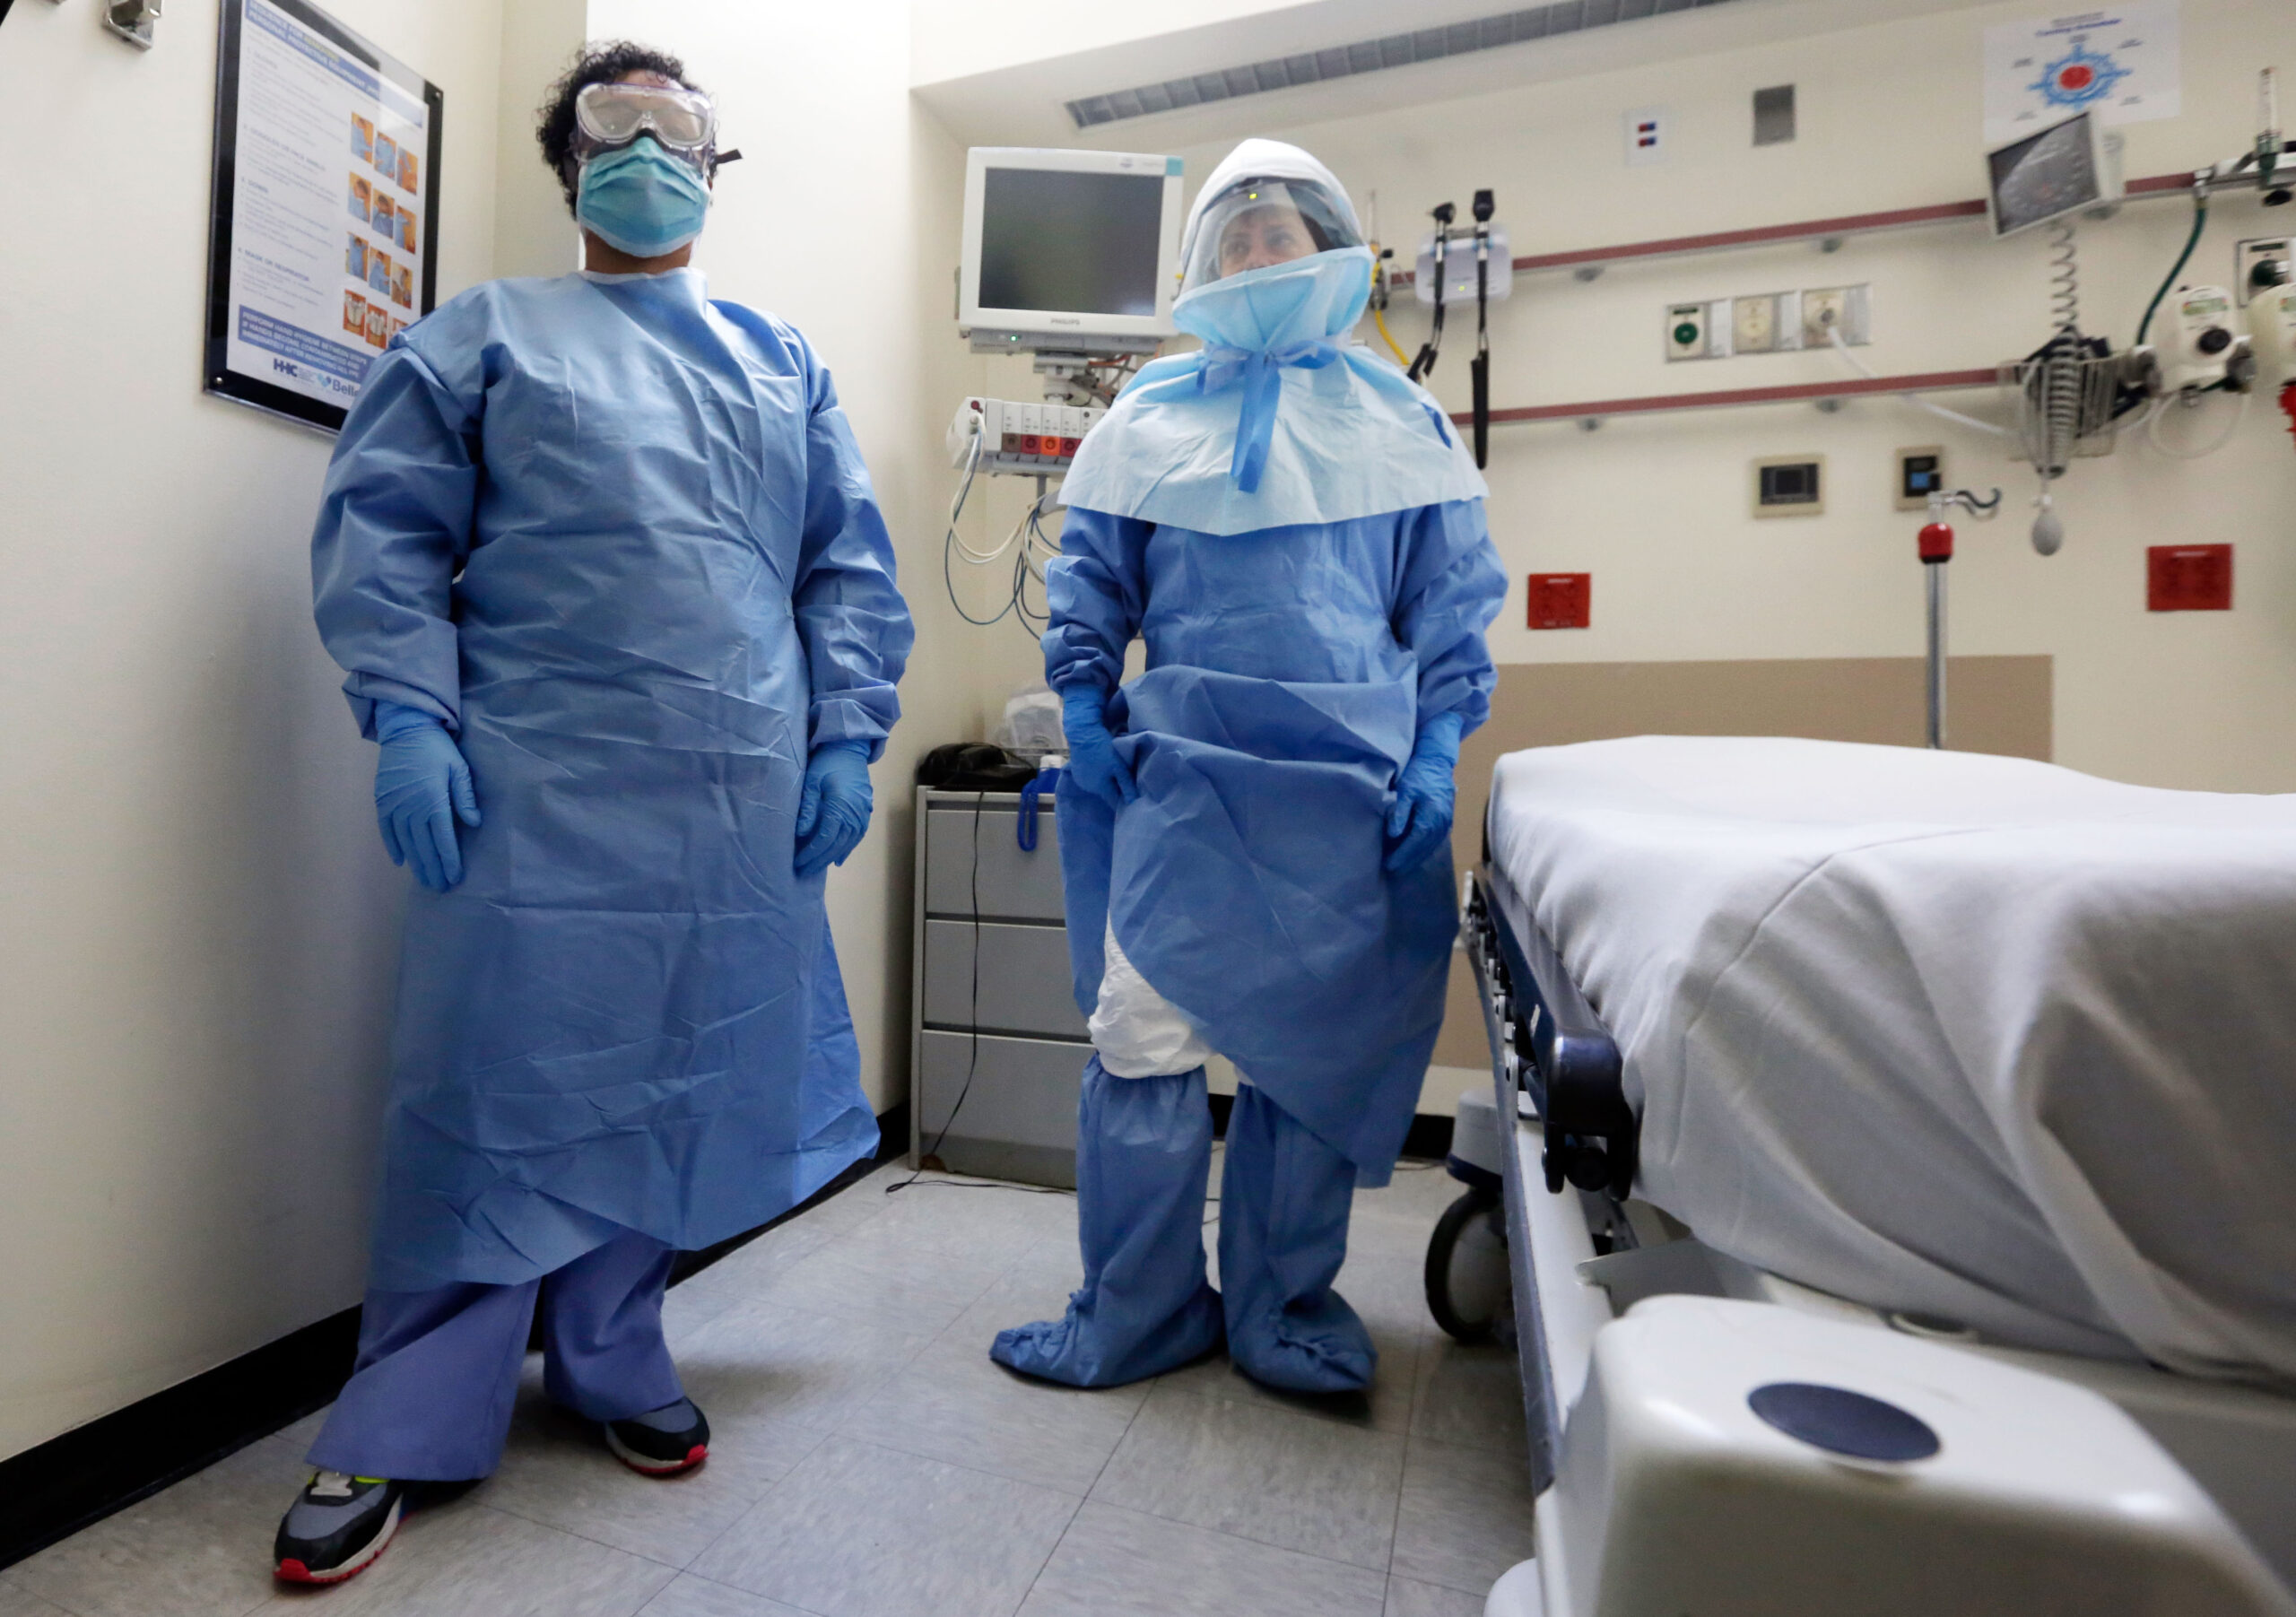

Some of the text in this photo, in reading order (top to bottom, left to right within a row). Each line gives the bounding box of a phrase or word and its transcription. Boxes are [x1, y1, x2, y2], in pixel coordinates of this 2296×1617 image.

[242, 310, 274, 329] PERFORM
[322, 342, 348, 358] BETWEEN
[249, 322, 272, 337] HANDS
[274, 331, 300, 347] BECOME
[274, 358, 298, 378] HHC
[285, 344, 304, 358] AFTER
[305, 352, 336, 369] REMOVING
